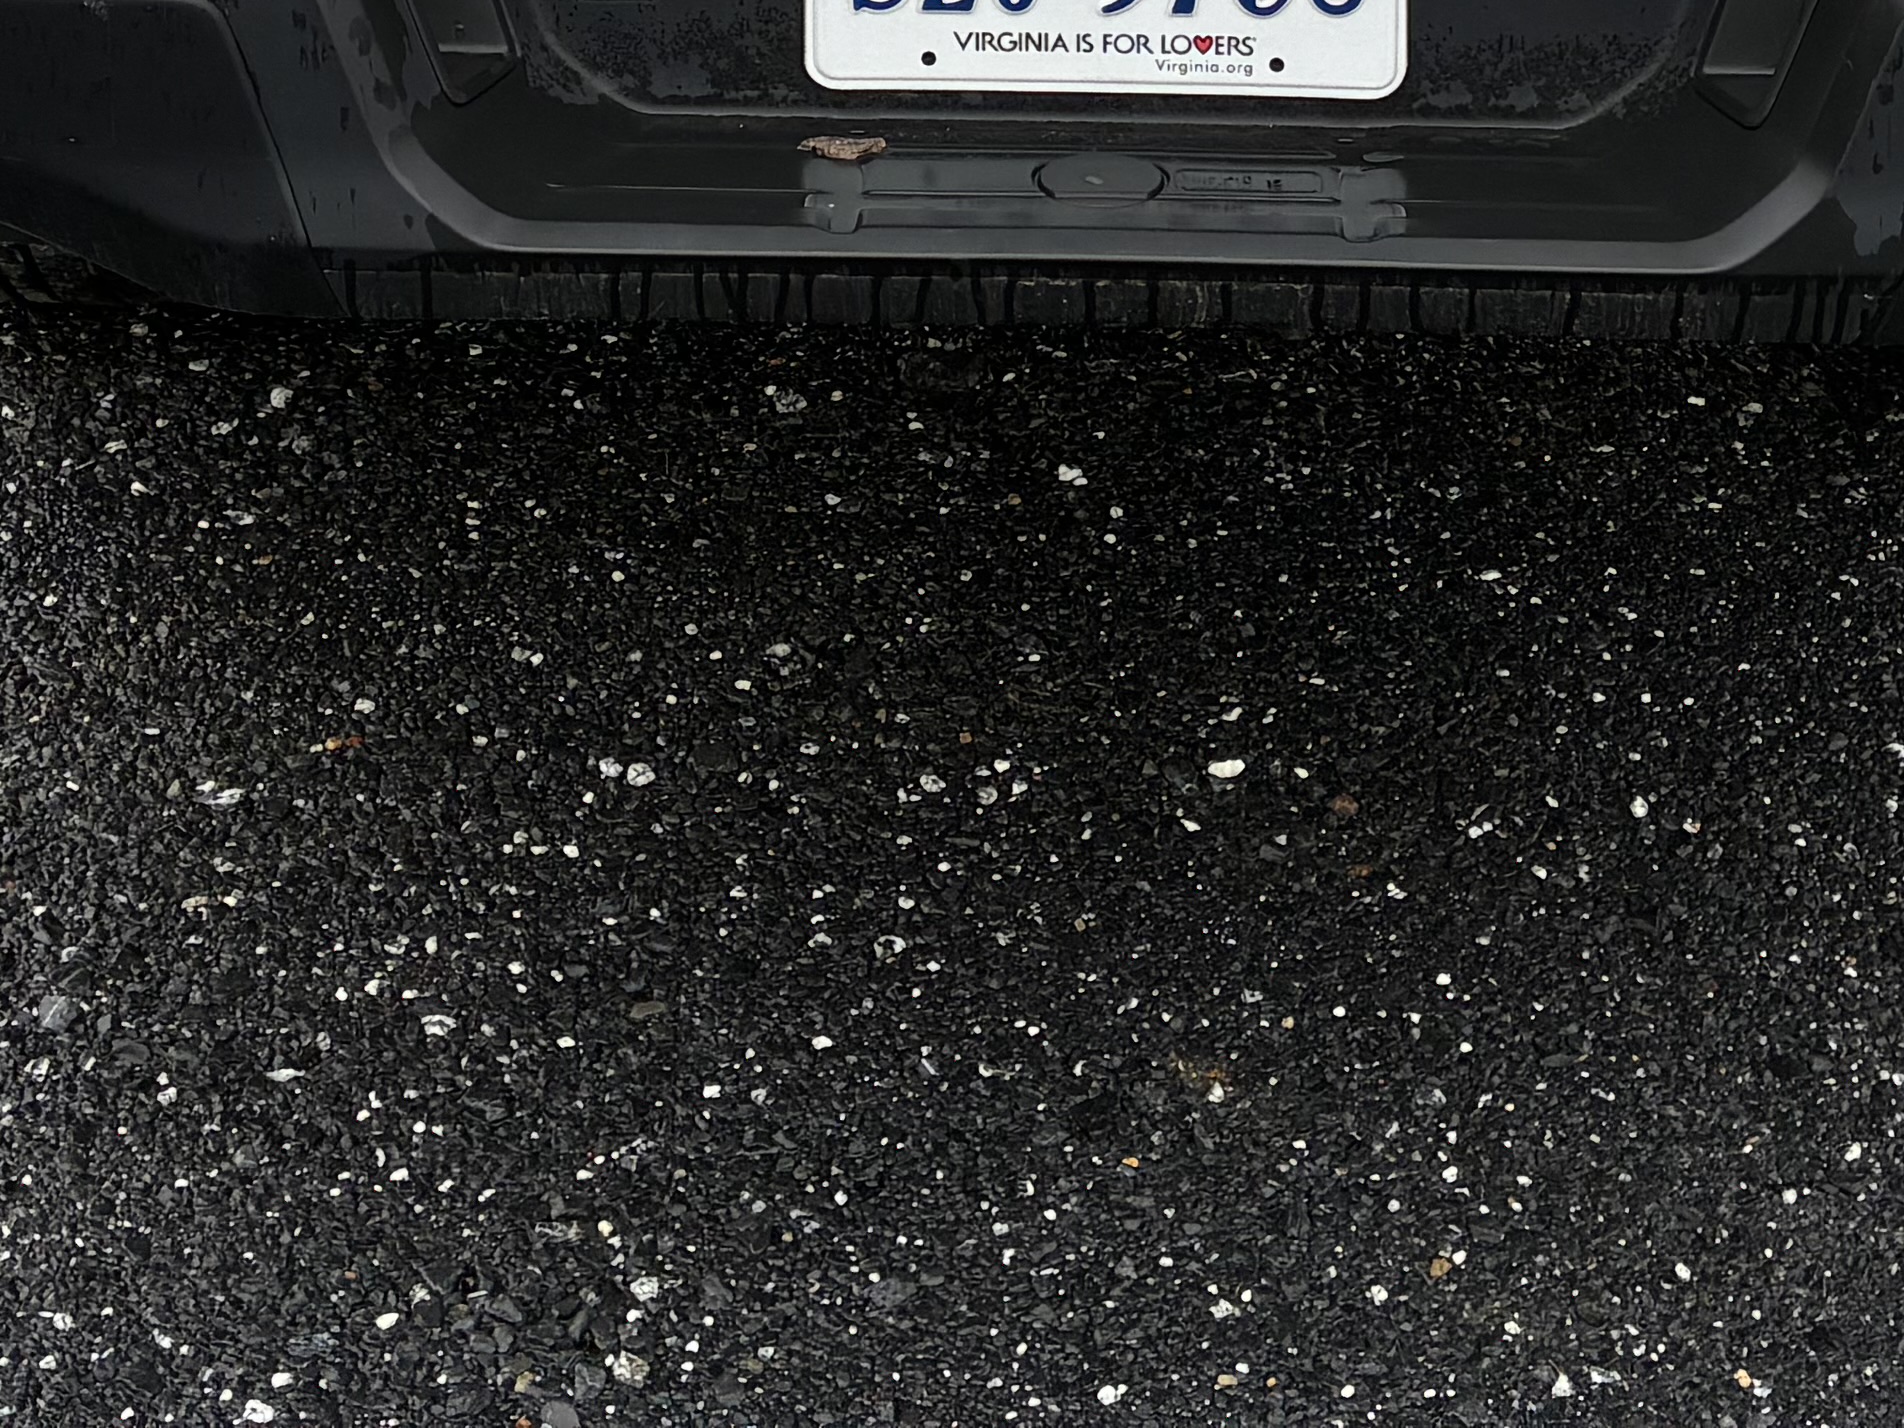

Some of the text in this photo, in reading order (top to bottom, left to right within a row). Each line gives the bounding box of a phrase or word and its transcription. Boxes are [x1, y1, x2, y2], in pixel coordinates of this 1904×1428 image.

[952, 30, 1070, 53] VIRGINIA
[1075, 32, 1095, 53] IS
[1102, 33, 1155, 55] FOR
[1154, 58, 1254, 77] Virginia.org
